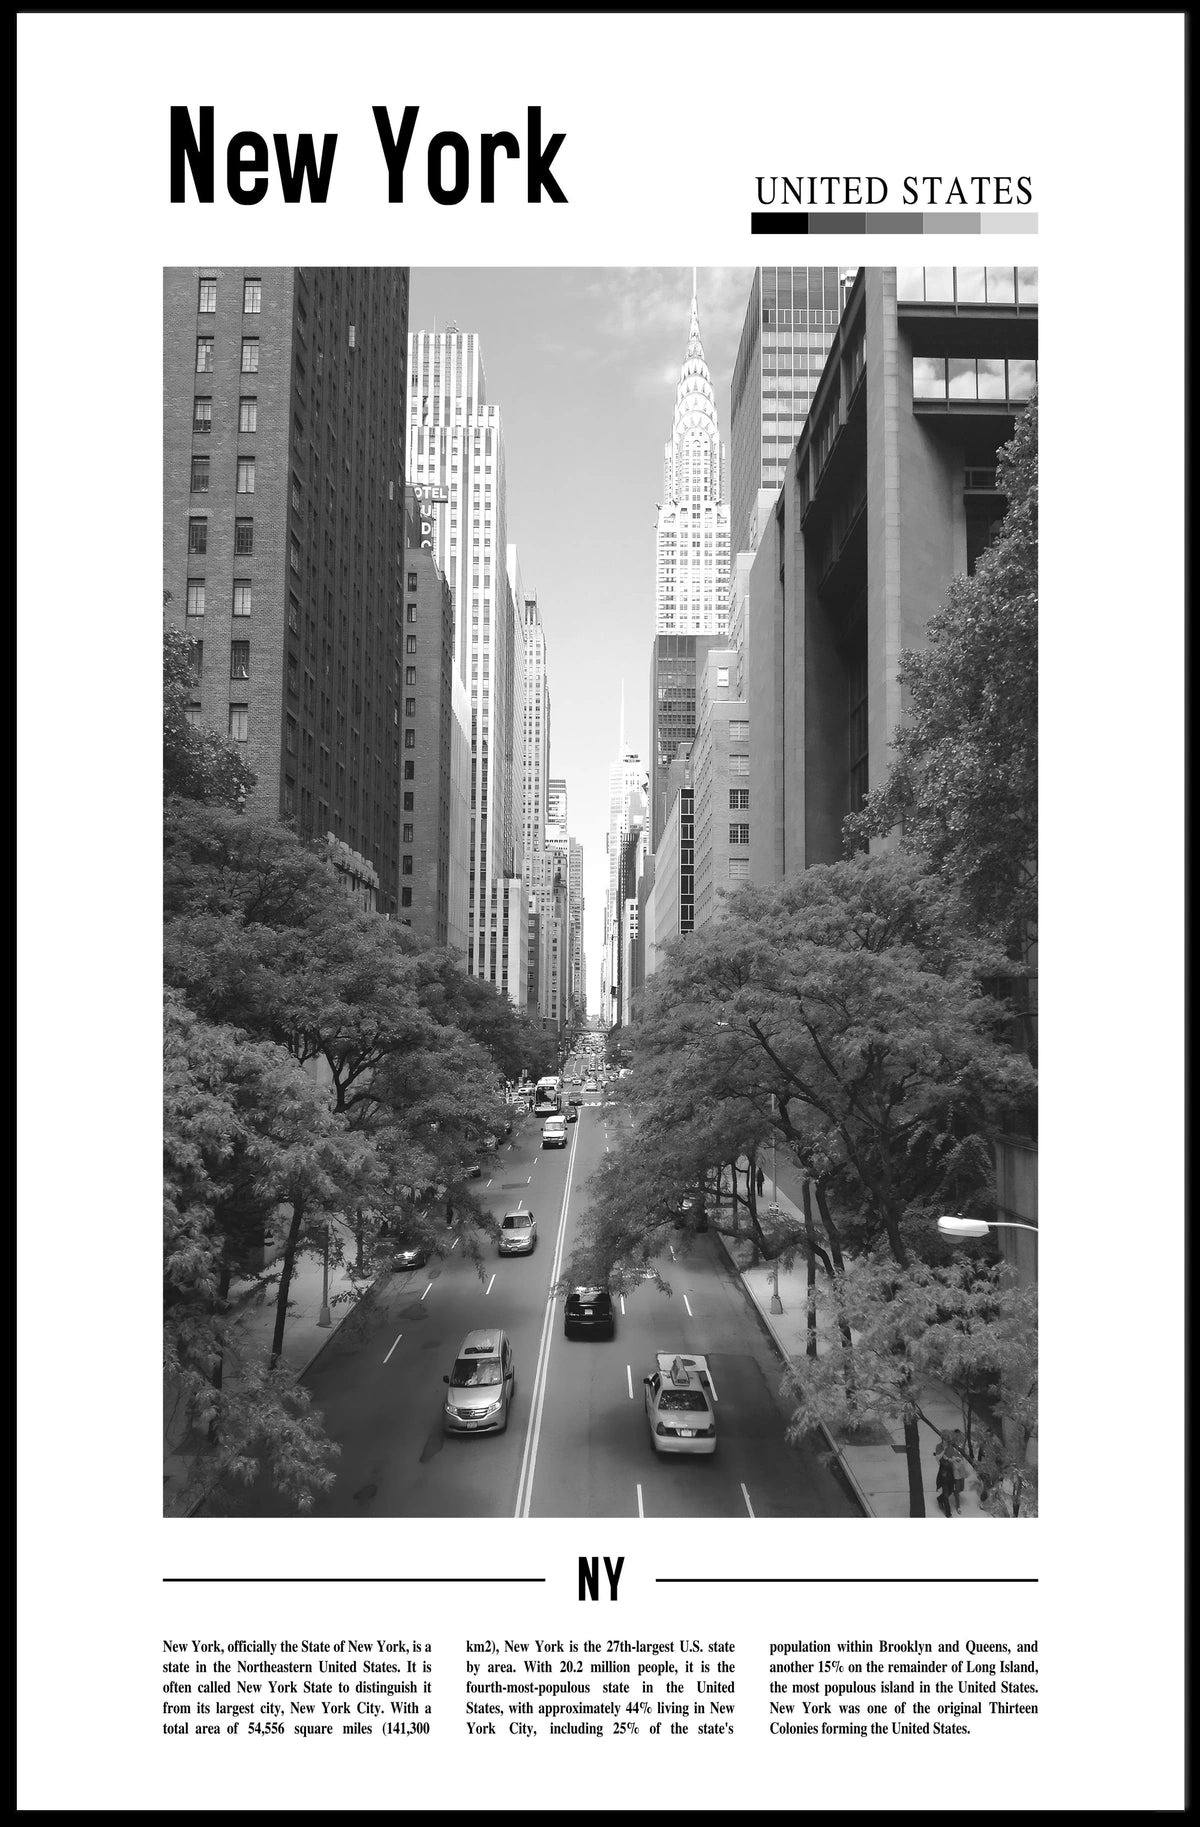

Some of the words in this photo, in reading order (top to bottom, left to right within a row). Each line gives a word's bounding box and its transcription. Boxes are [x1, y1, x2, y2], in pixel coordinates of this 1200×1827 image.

[171, 106, 338, 205] New
[372, 106, 568, 205] York
[755, 177, 887, 204] UNITED
[903, 177, 1032, 204] STATES
[579, 1557, 624, 1601] NY
[163, 1639, 189, 1653] New
[191, 1639, 225, 1655] York,
[227, 1639, 277, 1656] officially
[280, 1640, 299, 1653] the
[301, 1639, 331, 1653] State
[333, 1639, 346, 1653] of
[348, 1639, 374, 1653] New
[376, 1639, 410, 1655] York,
[412, 1639, 422, 1653] is
[424, 1643, 432, 1653] a
[466, 1639, 500, 1655] km2),
[504, 1639, 530, 1653] New
[534, 1639, 565, 1653] York
[569, 1639, 579, 1653] is
[583, 1640, 602, 1653] the
[606, 1639, 675, 1656] 27th-largest
[679, 1639, 704, 1653] U.S.
[708, 1641, 736, 1653] state
[769, 1639, 831, 1656] population
[836, 1639, 873, 1653] within
[879, 1639, 933, 1656] Brooklyn
[937, 1639, 960, 1653] and
[965, 1639, 1012, 1656] Queens,
[1016, 1639, 1039, 1653] and
[162, 1661, 190, 1673] state
[195, 1660, 207, 1673] in
[213, 1660, 232, 1673] the
[237, 1660, 313, 1673] Northeastern
[318, 1660, 357, 1674] United
[363, 1660, 401, 1673] States.
[407, 1660, 417, 1673] It
[422, 1660, 432, 1673] is
[466, 1660, 481, 1677] by
[487, 1663, 517, 1673] area.
[523, 1660, 553, 1673] With
[559, 1660, 584, 1673] 20.2
[590, 1660, 631, 1673] million
[637, 1660, 679, 1677] people,
[685, 1660, 694, 1673] it
[700, 1660, 710, 1673] is
[717, 1660, 736, 1673] the
[769, 1660, 815, 1673] another
[818, 1660, 844, 1673] 15%
[848, 1663, 863, 1673] on
[866, 1660, 885, 1673] the
[887, 1660, 948, 1673] remainder
[951, 1660, 964, 1673] of
[966, 1660, 997, 1676] Long
[999, 1660, 1039, 1675] Island,
[162, 1680, 192, 1694] often
[197, 1680, 231, 1694] called
[236, 1680, 263, 1694] New
[268, 1680, 298, 1694] York
[303, 1680, 333, 1694] State
[338, 1681, 350, 1694] to
[355, 1680, 418, 1697] distinguish
[423, 1680, 432, 1694] it
[466, 1680, 591, 1697] fourth-most-populous
[602, 1681, 630, 1694] state
[642, 1680, 654, 1694] in
[666, 1680, 684, 1694] the
[696, 1680, 735, 1694] United
[769, 1680, 788, 1694] the
[792, 1681, 820, 1694] most
[824, 1680, 877, 1697] populous
[880, 1680, 915, 1694] island
[919, 1680, 931, 1694] in
[935, 1680, 954, 1694] the
[958, 1680, 997, 1694] United
[1000, 1680, 1039, 1694] States.
[162, 1701, 191, 1714] from
[196, 1701, 211, 1715] its
[215, 1701, 255, 1718] largest
[260, 1701, 285, 1718] city,
[290, 1701, 316, 1714] New
[321, 1701, 351, 1714] York
[356, 1701, 385, 1718] City.
[390, 1701, 419, 1714] With
[424, 1704, 432, 1714] a
[466, 1701, 504, 1716] States,
[508, 1701, 534, 1714] with
[538, 1701, 621, 1718] approximately
[625, 1701, 652, 1714] 44%
[657, 1701, 690, 1718] living
[693, 1701, 705, 1714] in
[709, 1701, 735, 1714] New
[769, 1701, 795, 1714] New
[801, 1701, 832, 1714] York
[838, 1704, 861, 1715] was
[866, 1704, 888, 1715] one
[894, 1701, 907, 1715] of
[912, 1701, 931, 1714] the
[937, 1701, 982, 1718] original
[988, 1701, 1039, 1714] Thirteen
[162, 1721, 189, 1735] total
[195, 1725, 221, 1735] area
[226, 1721, 240, 1735] of
[247, 1721, 285, 1737] 54,556
[294, 1725, 333, 1738] square
[342, 1721, 373, 1735] miles
[382, 1721, 430, 1737] (141,300
[466, 1721, 496, 1735] York
[509, 1721, 537, 1738] City,
[549, 1721, 604, 1738] including
[613, 1721, 639, 1735] 25%
[649, 1721, 662, 1735] of
[670, 1721, 689, 1735] the
[697, 1721, 734, 1735] state's
[769, 1721, 819, 1735] Colonies
[821, 1721, 868, 1738] forming
[870, 1721, 889, 1735] the
[891, 1721, 930, 1735] United
[932, 1721, 971, 1735] States.
